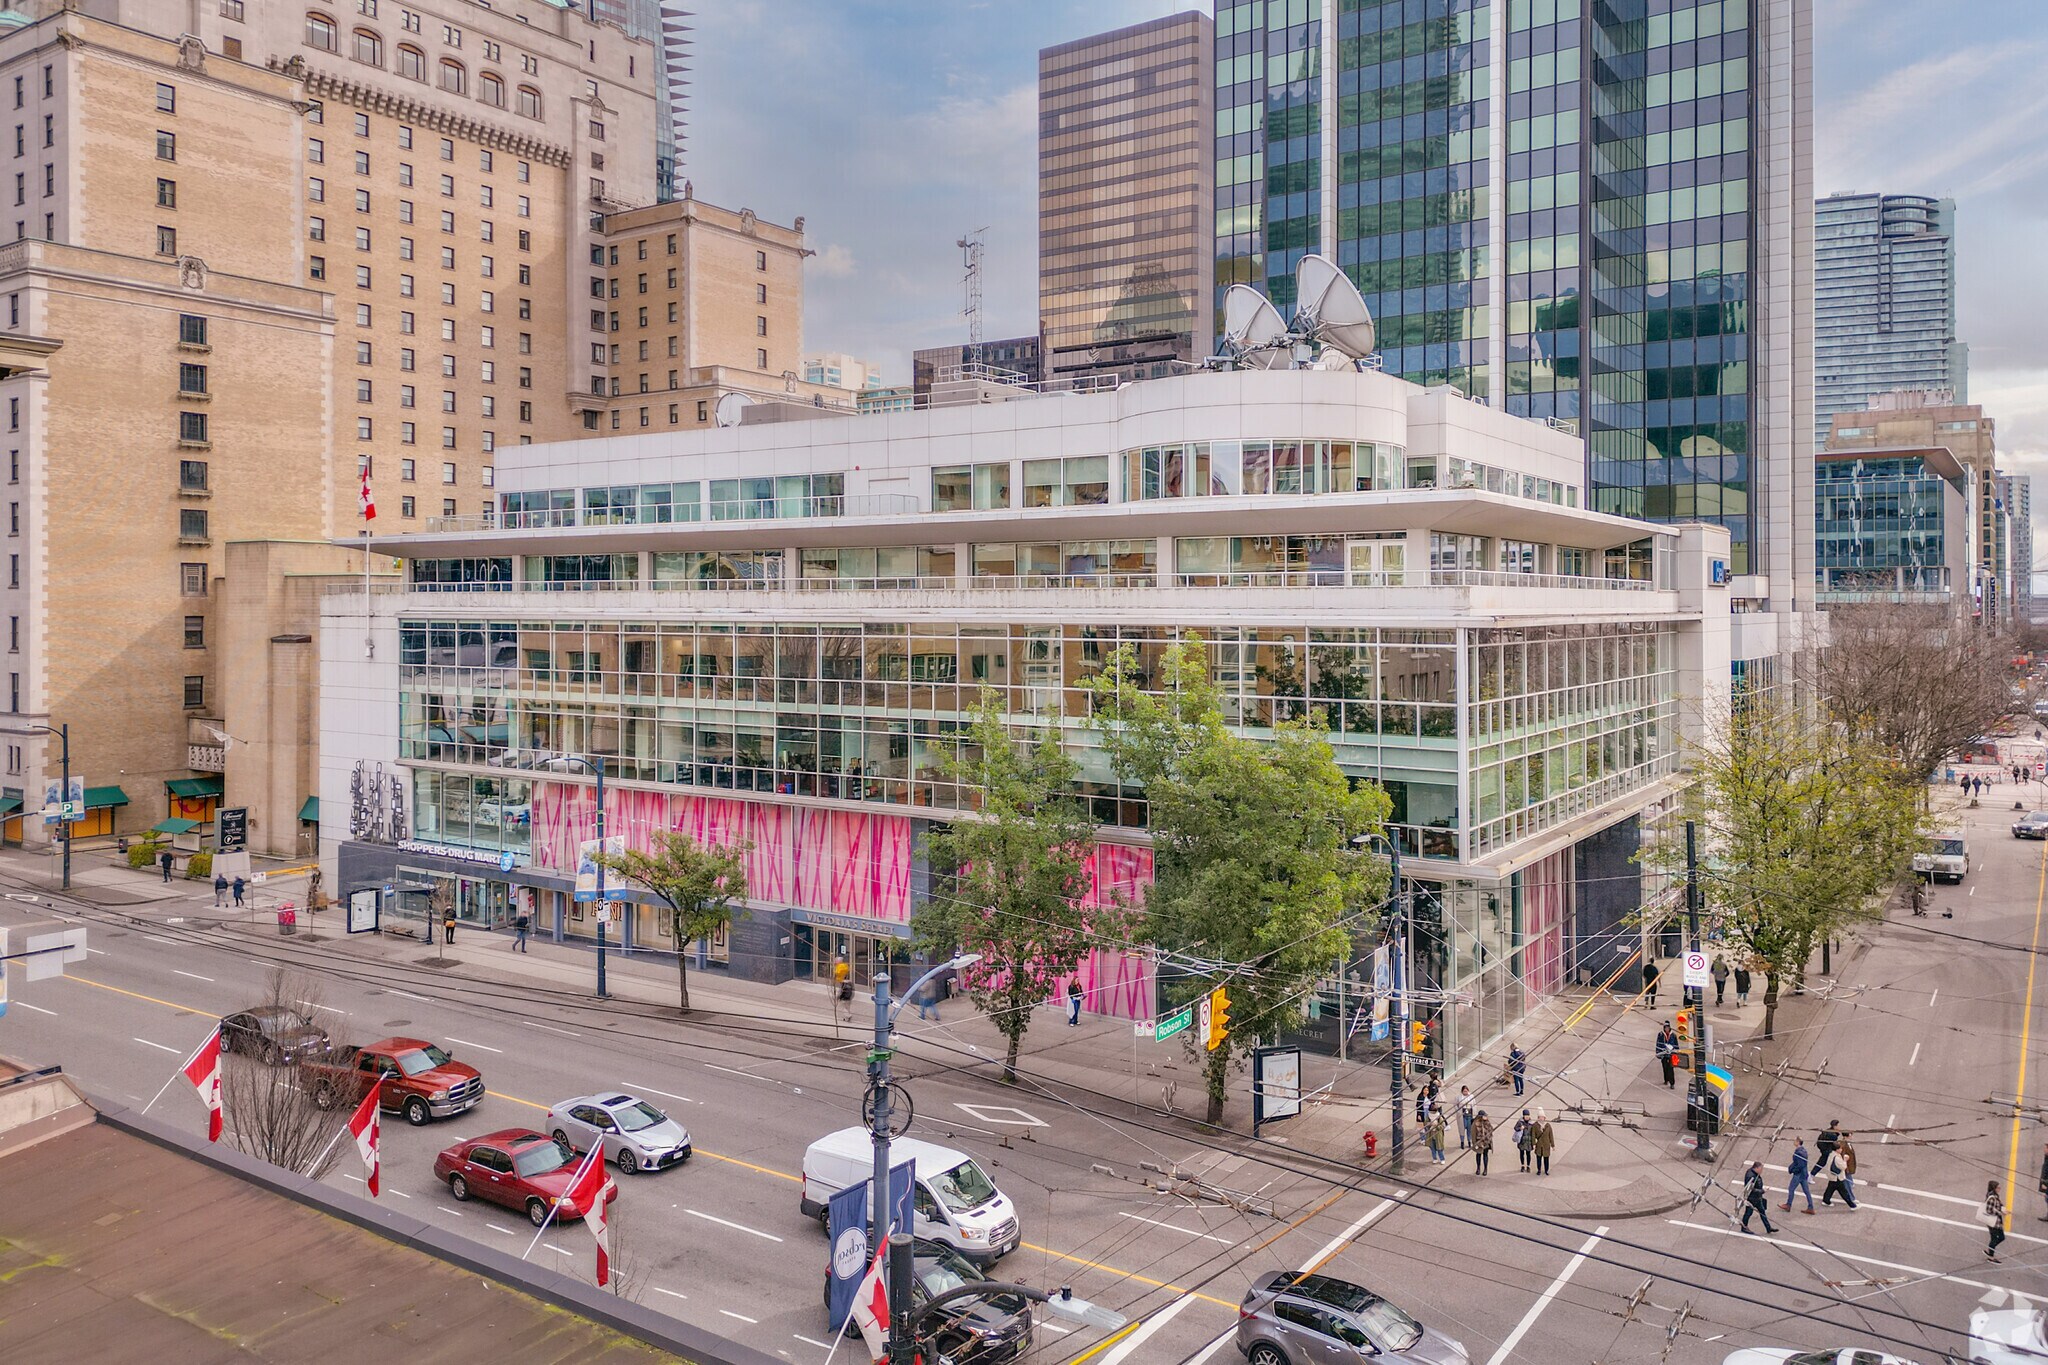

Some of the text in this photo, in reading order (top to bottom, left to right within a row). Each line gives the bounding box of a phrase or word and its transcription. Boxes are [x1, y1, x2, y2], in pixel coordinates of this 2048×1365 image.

[398, 840, 501, 864] SHOPPERS DRUG MART
[860, 921, 895, 935] SECRET
[1158, 1012, 1190, 1038] Robson St
[1295, 1029, 1324, 1039] SECRET
[1405, 1055, 1429, 1065] Burrard
